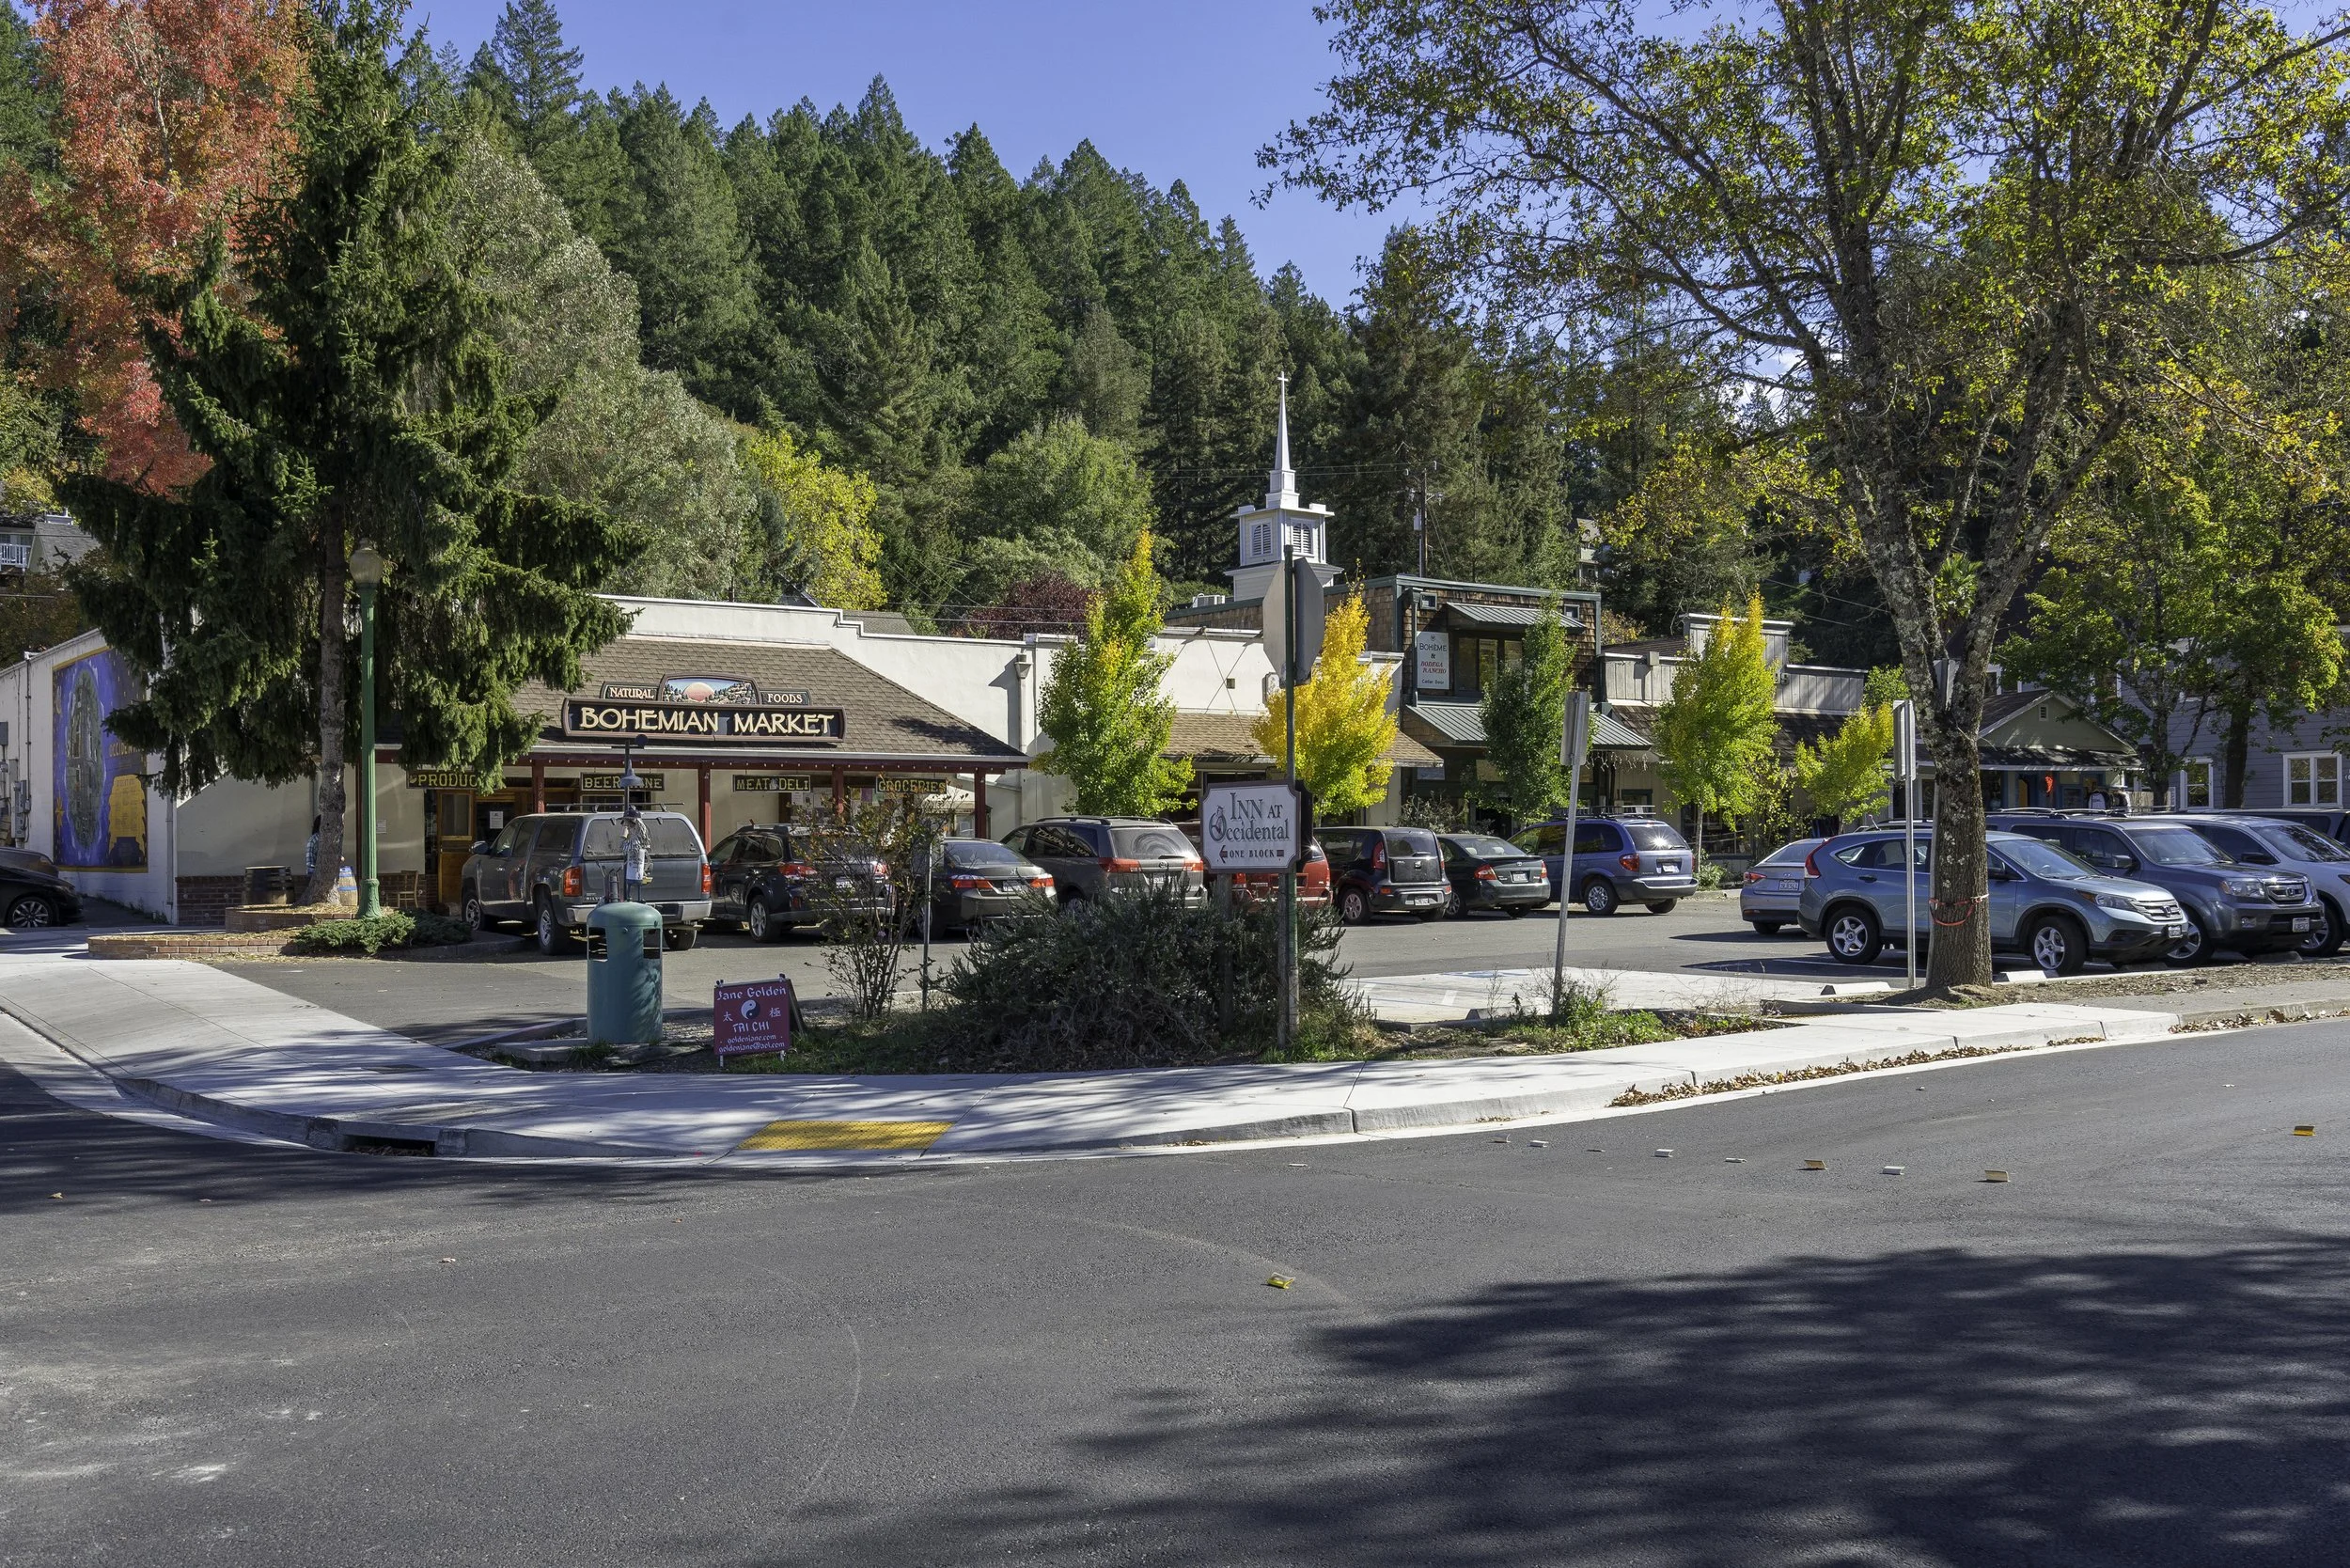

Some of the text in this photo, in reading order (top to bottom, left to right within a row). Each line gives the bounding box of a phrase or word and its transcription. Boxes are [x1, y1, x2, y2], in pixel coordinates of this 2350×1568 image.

[609, 687, 803, 704] NATURAL FOODS
[579, 706, 835, 734] BOHEMIAN MARKET
[418, 773, 478, 787] PRODUC
[584, 776, 621, 789] BEER
[736, 777, 808, 791] MEAT DELI
[878, 779, 946, 792] GROCERIES
[1230, 792, 1283, 821] INN AT
[1209, 812, 1290, 842] Occidental
[1229, 848, 1275, 858] ONE BLOCK
[716, 986, 787, 1000] Jane Golden
[723, 1011, 733, 1022] 太
[732, 1021, 770, 1033] TAI CHI
